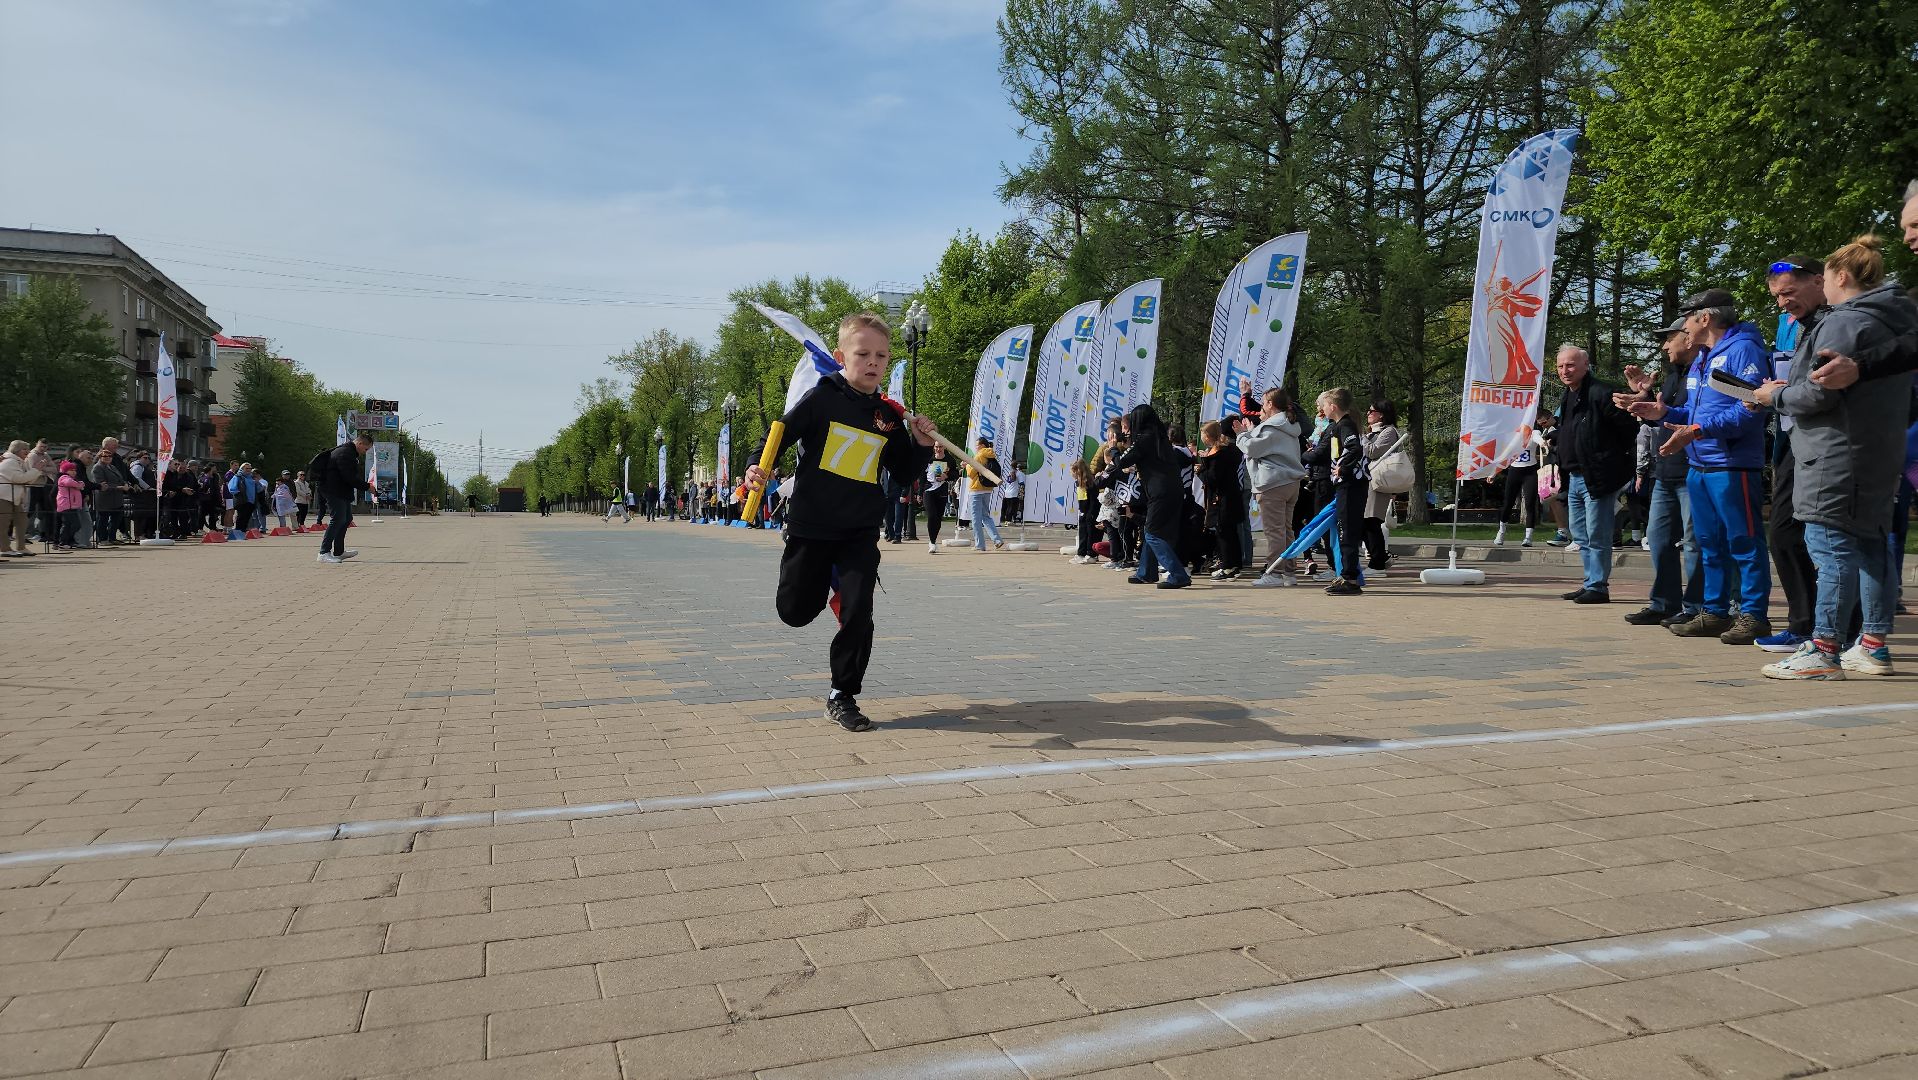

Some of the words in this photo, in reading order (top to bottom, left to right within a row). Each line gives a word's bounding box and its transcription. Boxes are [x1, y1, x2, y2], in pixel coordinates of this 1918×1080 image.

[1220, 358, 1251, 419] ПОРТ
[1470, 387, 1537, 409] ПОБЕДА
[979, 405, 998, 441] ОРТ
[1043, 393, 1068, 453] СПОРТ
[829, 427, 884, 477] 77
